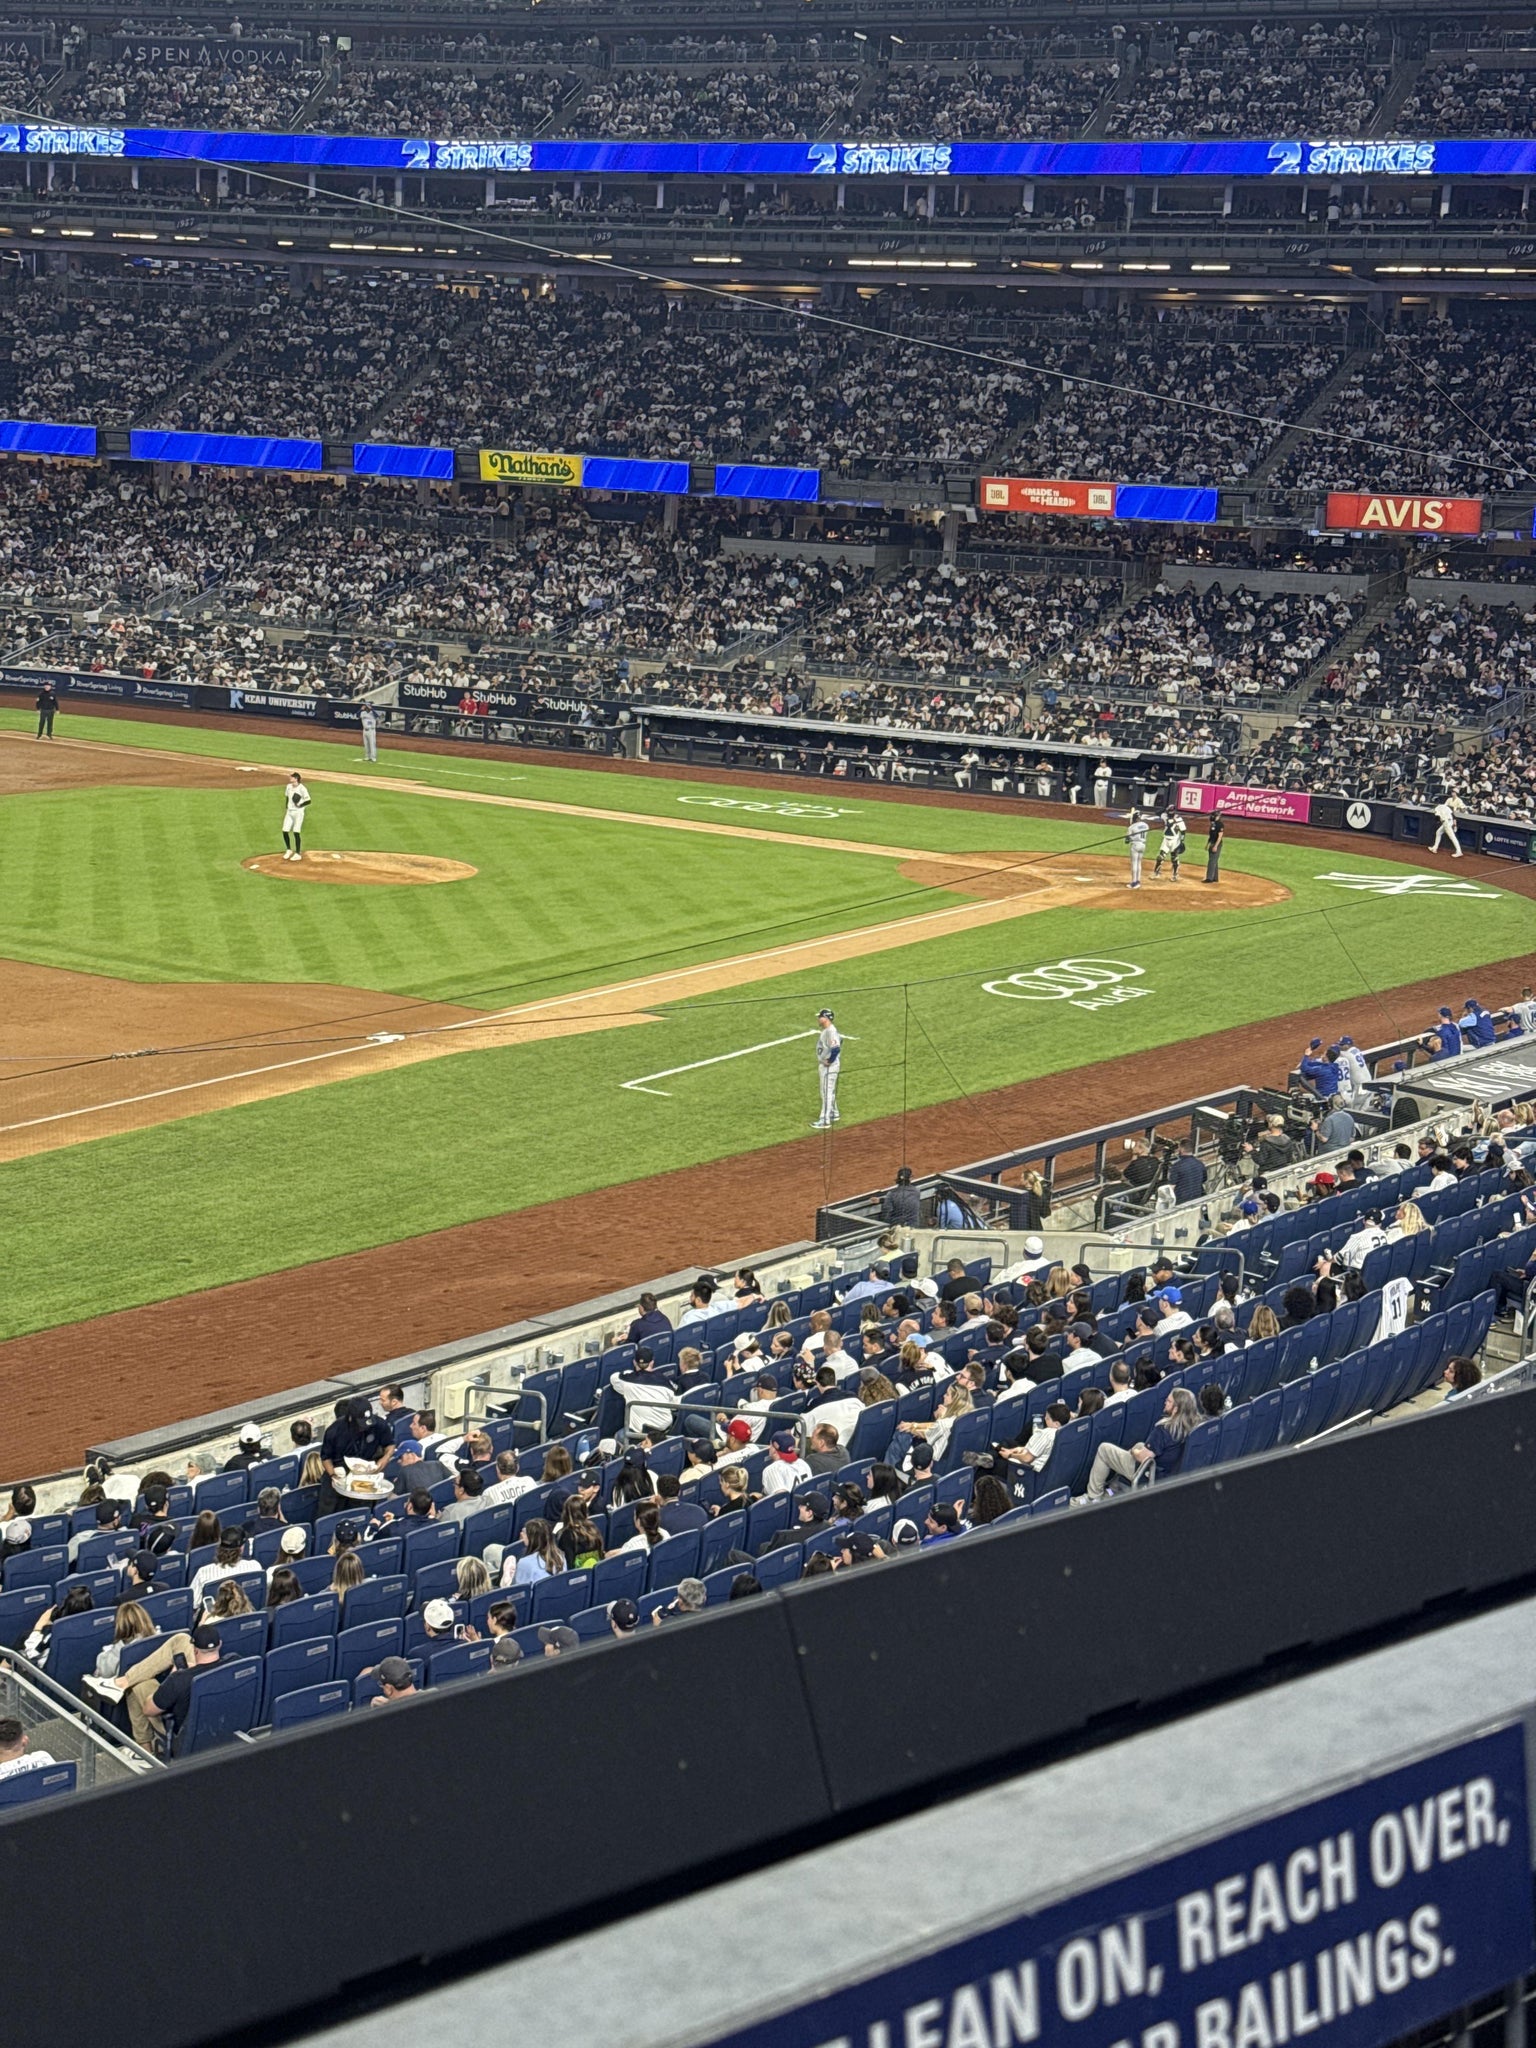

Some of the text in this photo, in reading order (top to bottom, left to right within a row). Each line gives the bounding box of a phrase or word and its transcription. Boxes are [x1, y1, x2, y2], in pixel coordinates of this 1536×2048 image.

[123, 45, 287, 65] ASPEN VODKA
[25, 130, 126, 154] STRIKES
[401, 140, 533, 170] 2 STRIKES
[807, 143, 952, 174] 2 STRIKES
[1267, 142, 1436, 174] 2 STRIKES
[1285, 243, 1310, 253] 1947
[488, 452, 574, 477] Nathan's
[1360, 498, 1444, 530] AVIS
[244, 694, 317, 711] KEAN UNIVERSITY
[403, 684, 447, 700] StubHub
[472, 690, 517, 706] StubHub
[1216, 799, 1296, 817] Best Network
[1226, 790, 1287, 806] America's
[1068, 985, 1156, 1011] Audi
[1057, 1915, 1164, 2023] ON,
[1176, 1831, 1358, 1972] REACH
[1370, 1776, 1511, 1888] OVER,
[1196, 1904, 1457, 2048] RAILINGS.
